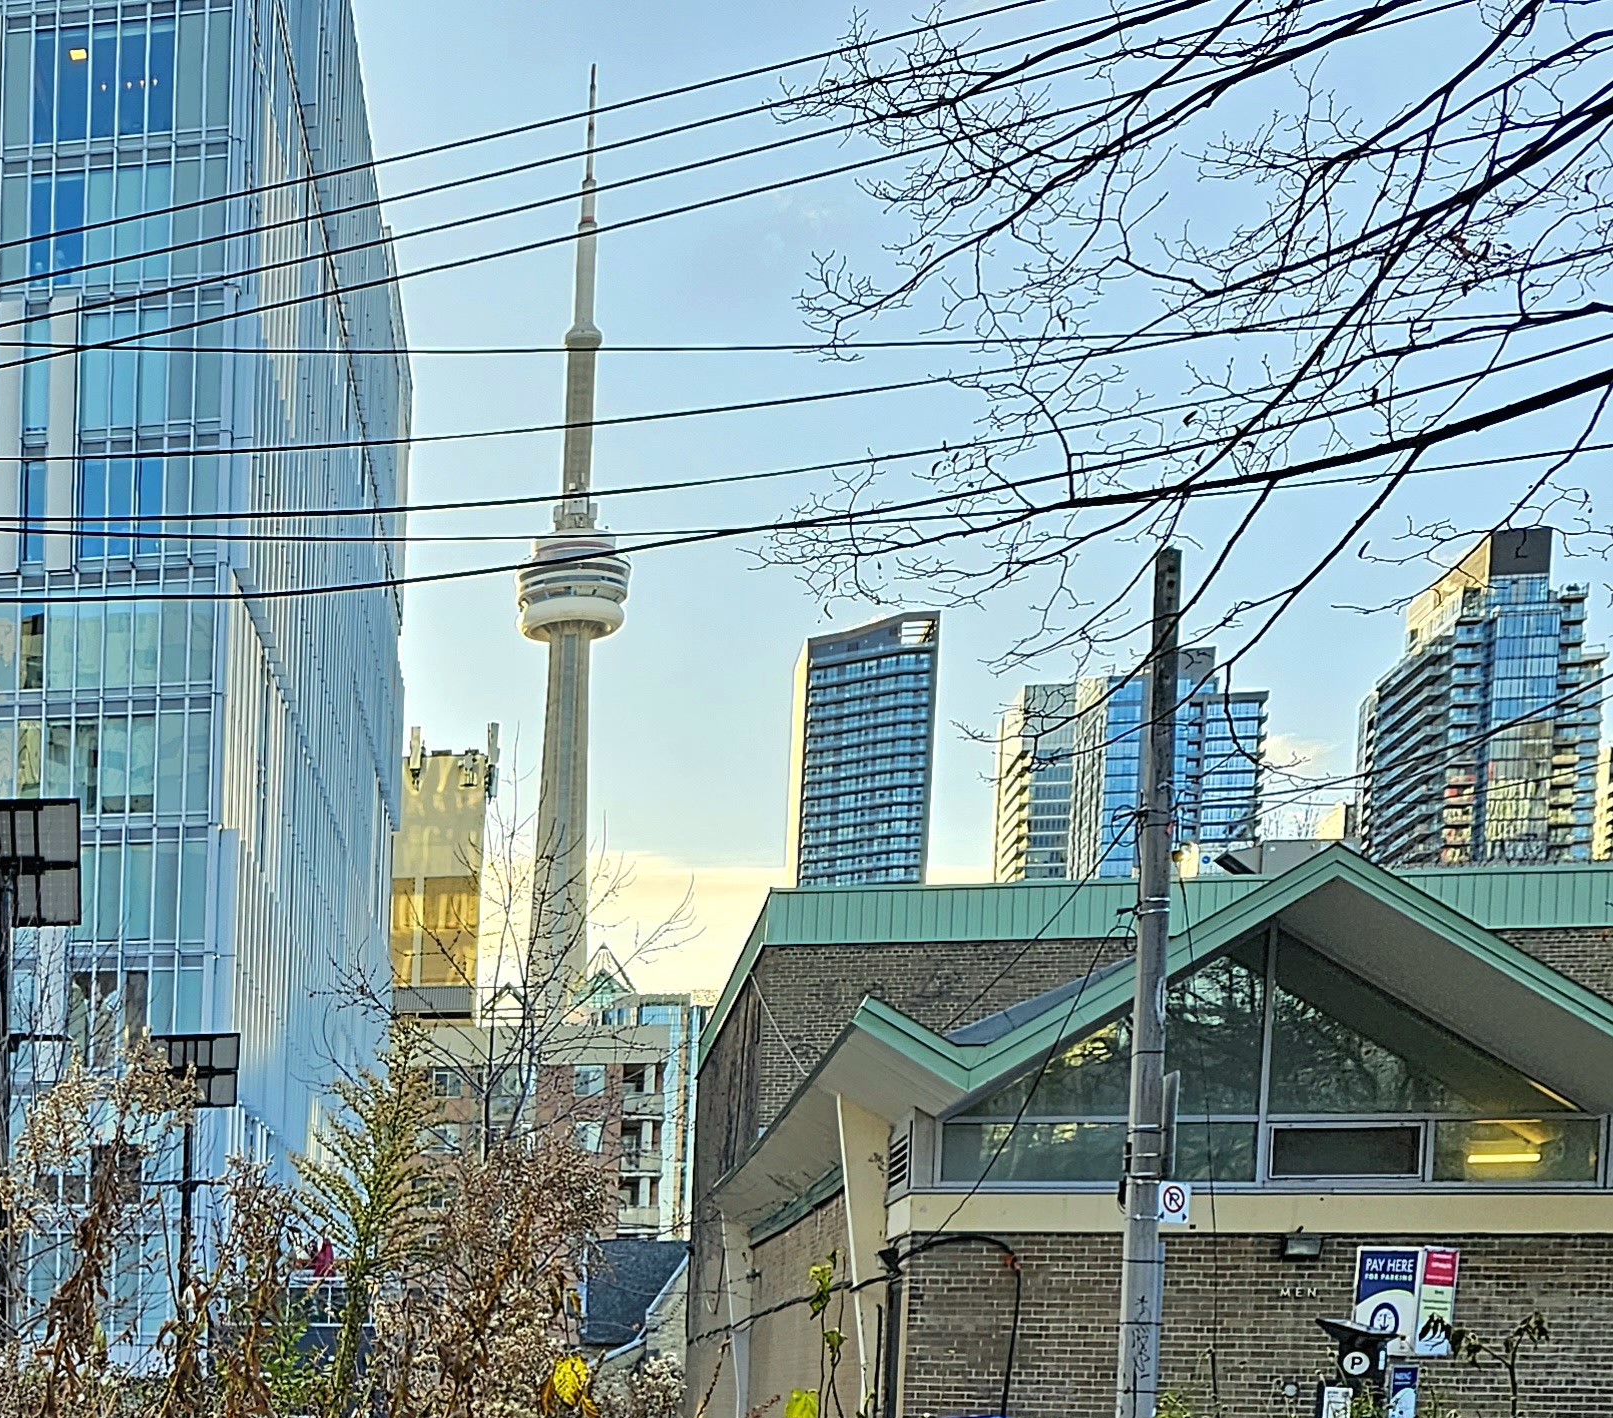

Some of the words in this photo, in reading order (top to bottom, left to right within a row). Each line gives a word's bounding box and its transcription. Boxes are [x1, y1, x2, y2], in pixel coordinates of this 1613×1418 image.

[1365, 1258, 1386, 1272] PAY
[1386, 1258, 1415, 1273] HERE
[1380, 1273, 1413, 1282] PARKING
[1279, 1287, 1318, 1298] MEN
[1350, 1356, 1363, 1370] P
